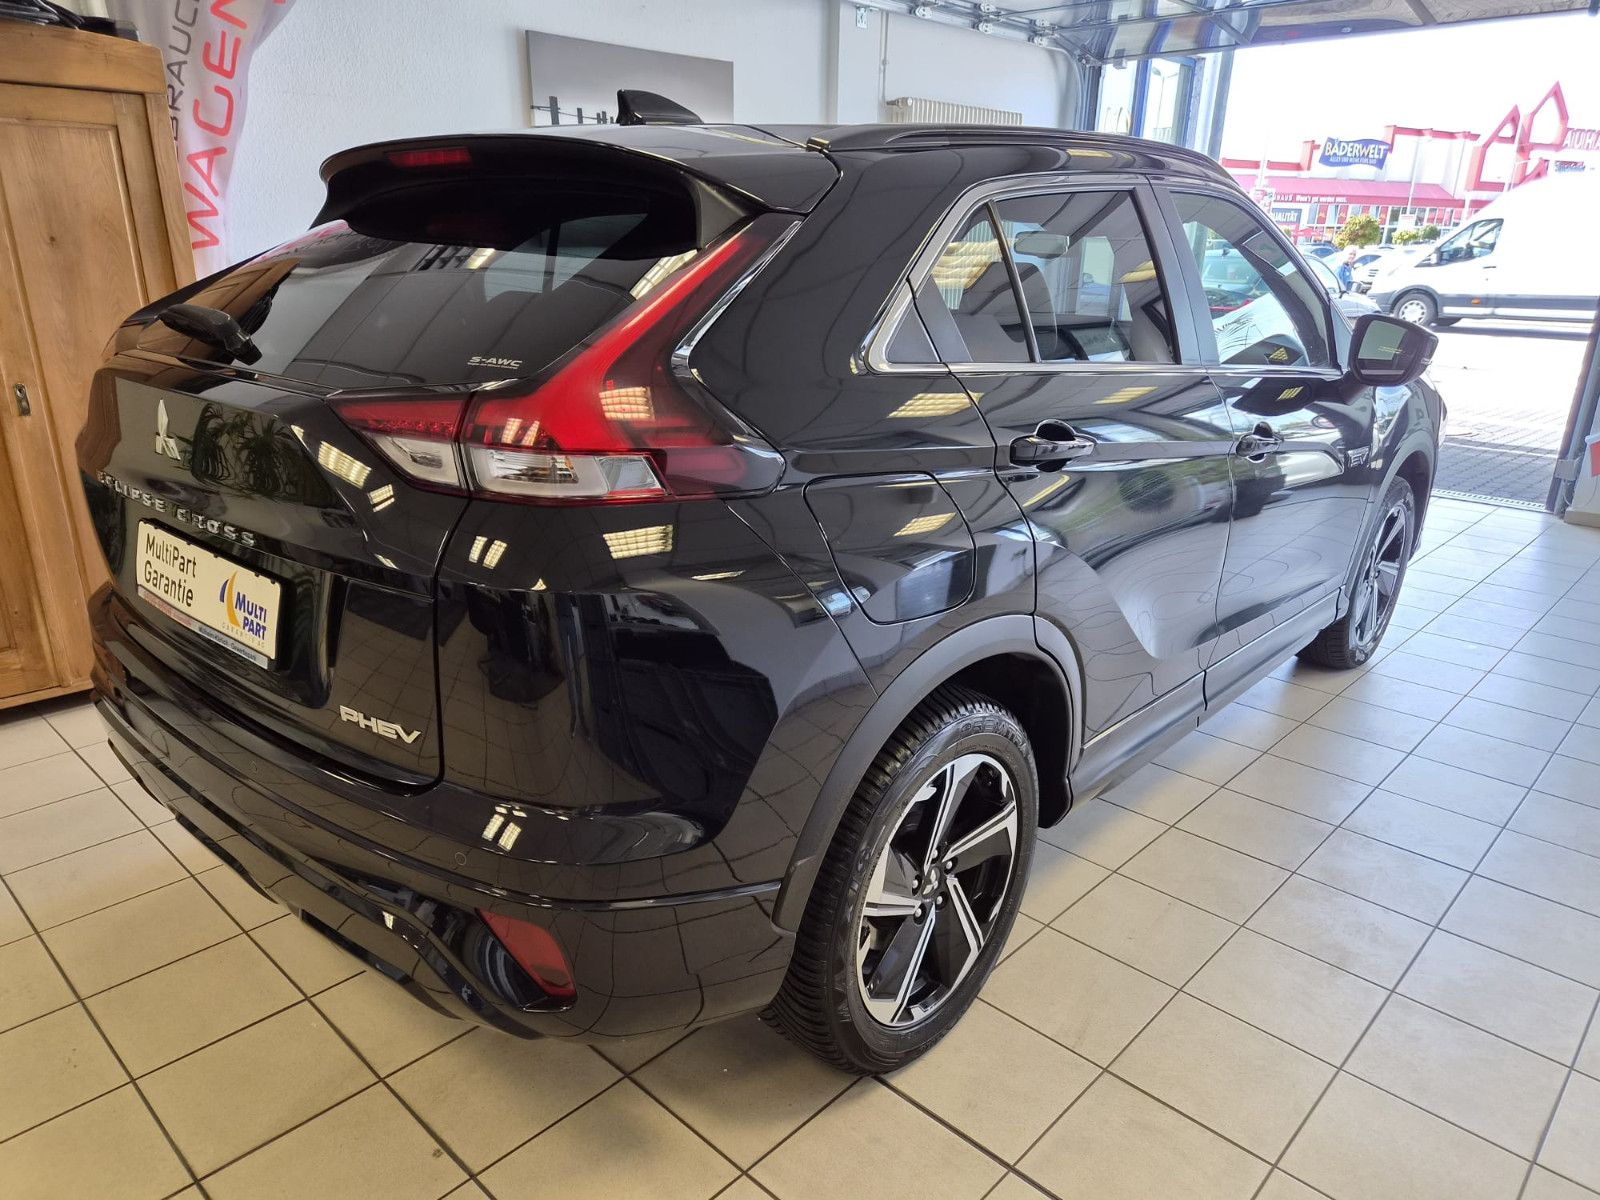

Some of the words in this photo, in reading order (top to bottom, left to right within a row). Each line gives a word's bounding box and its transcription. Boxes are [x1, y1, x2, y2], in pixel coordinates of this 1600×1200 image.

[468, 356, 523, 368] S-AWC
[97, 470, 167, 513] ECLIPSE
[176, 508, 255, 547] CROSS
[145, 533, 197, 578] MultiPart
[144, 560, 194, 607] Garantie
[235, 592, 267, 623] MULTI
[243, 616, 267, 640] PART
[340, 705, 421, 743] PHEV
